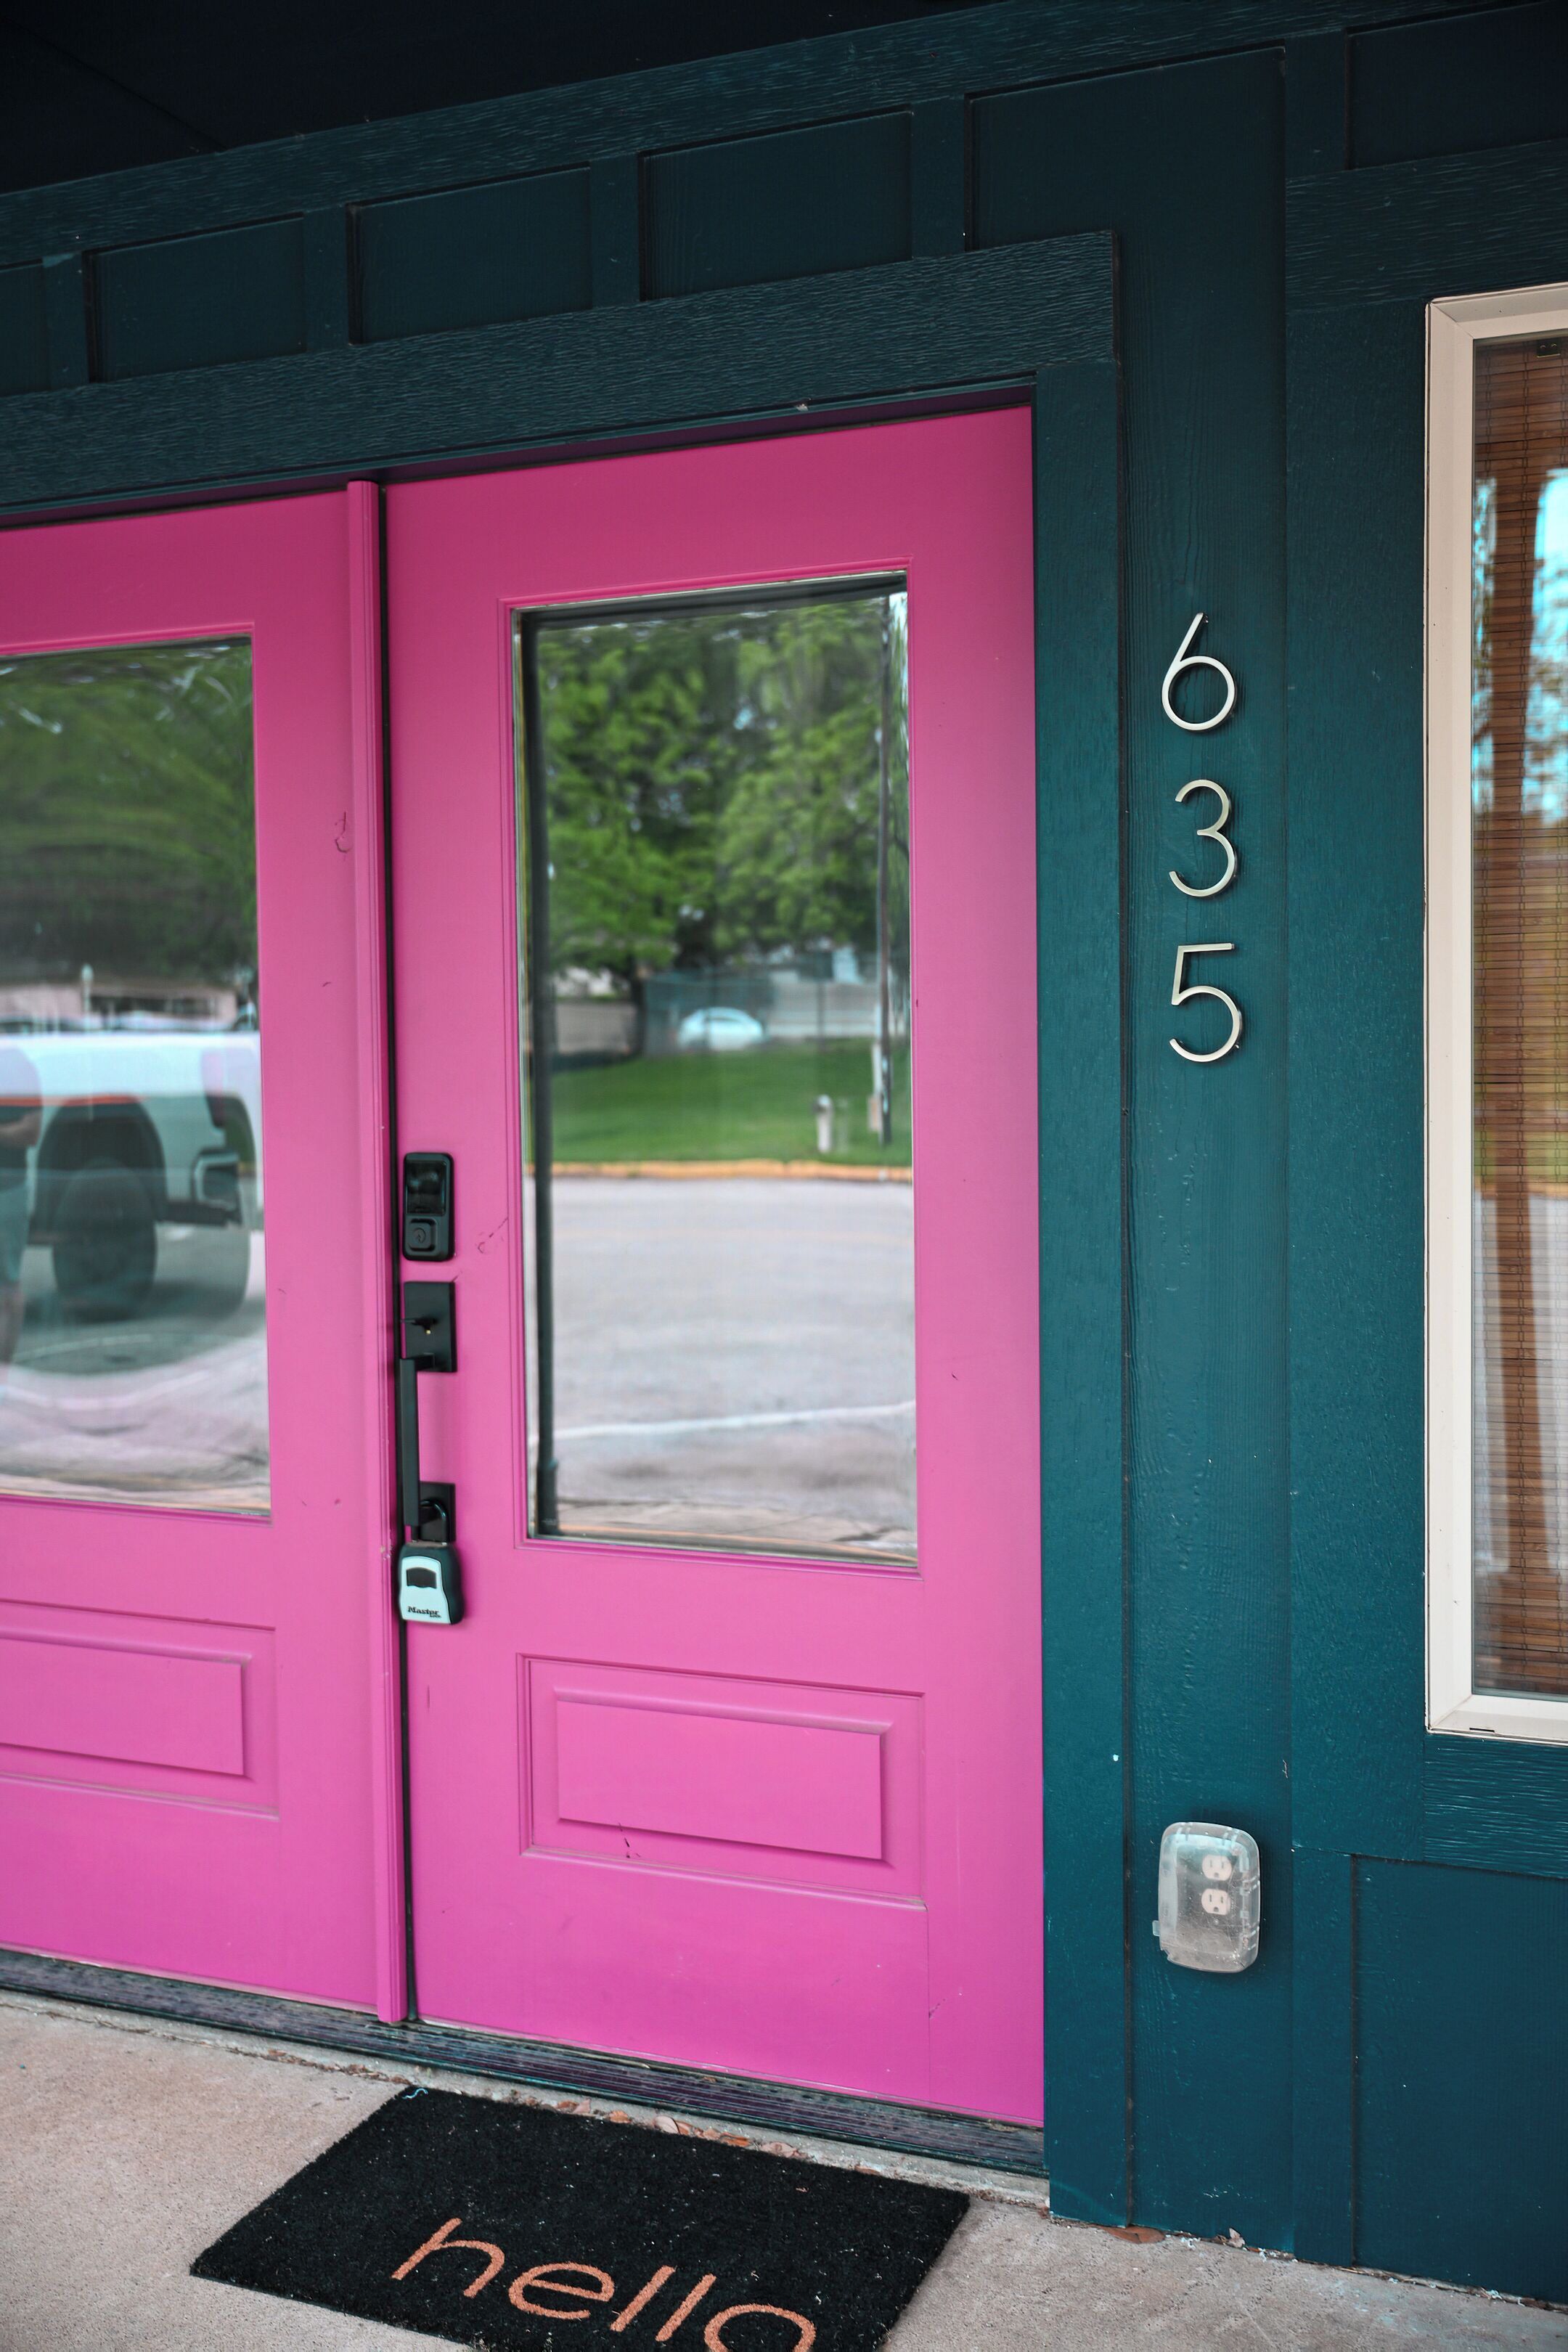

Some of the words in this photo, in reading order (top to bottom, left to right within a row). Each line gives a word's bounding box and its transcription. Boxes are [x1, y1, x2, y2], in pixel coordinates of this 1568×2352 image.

[1161, 613, 1242, 1063] 635
[407, 1606, 439, 1615] Master
[391, 2217, 816, 2352] hello
